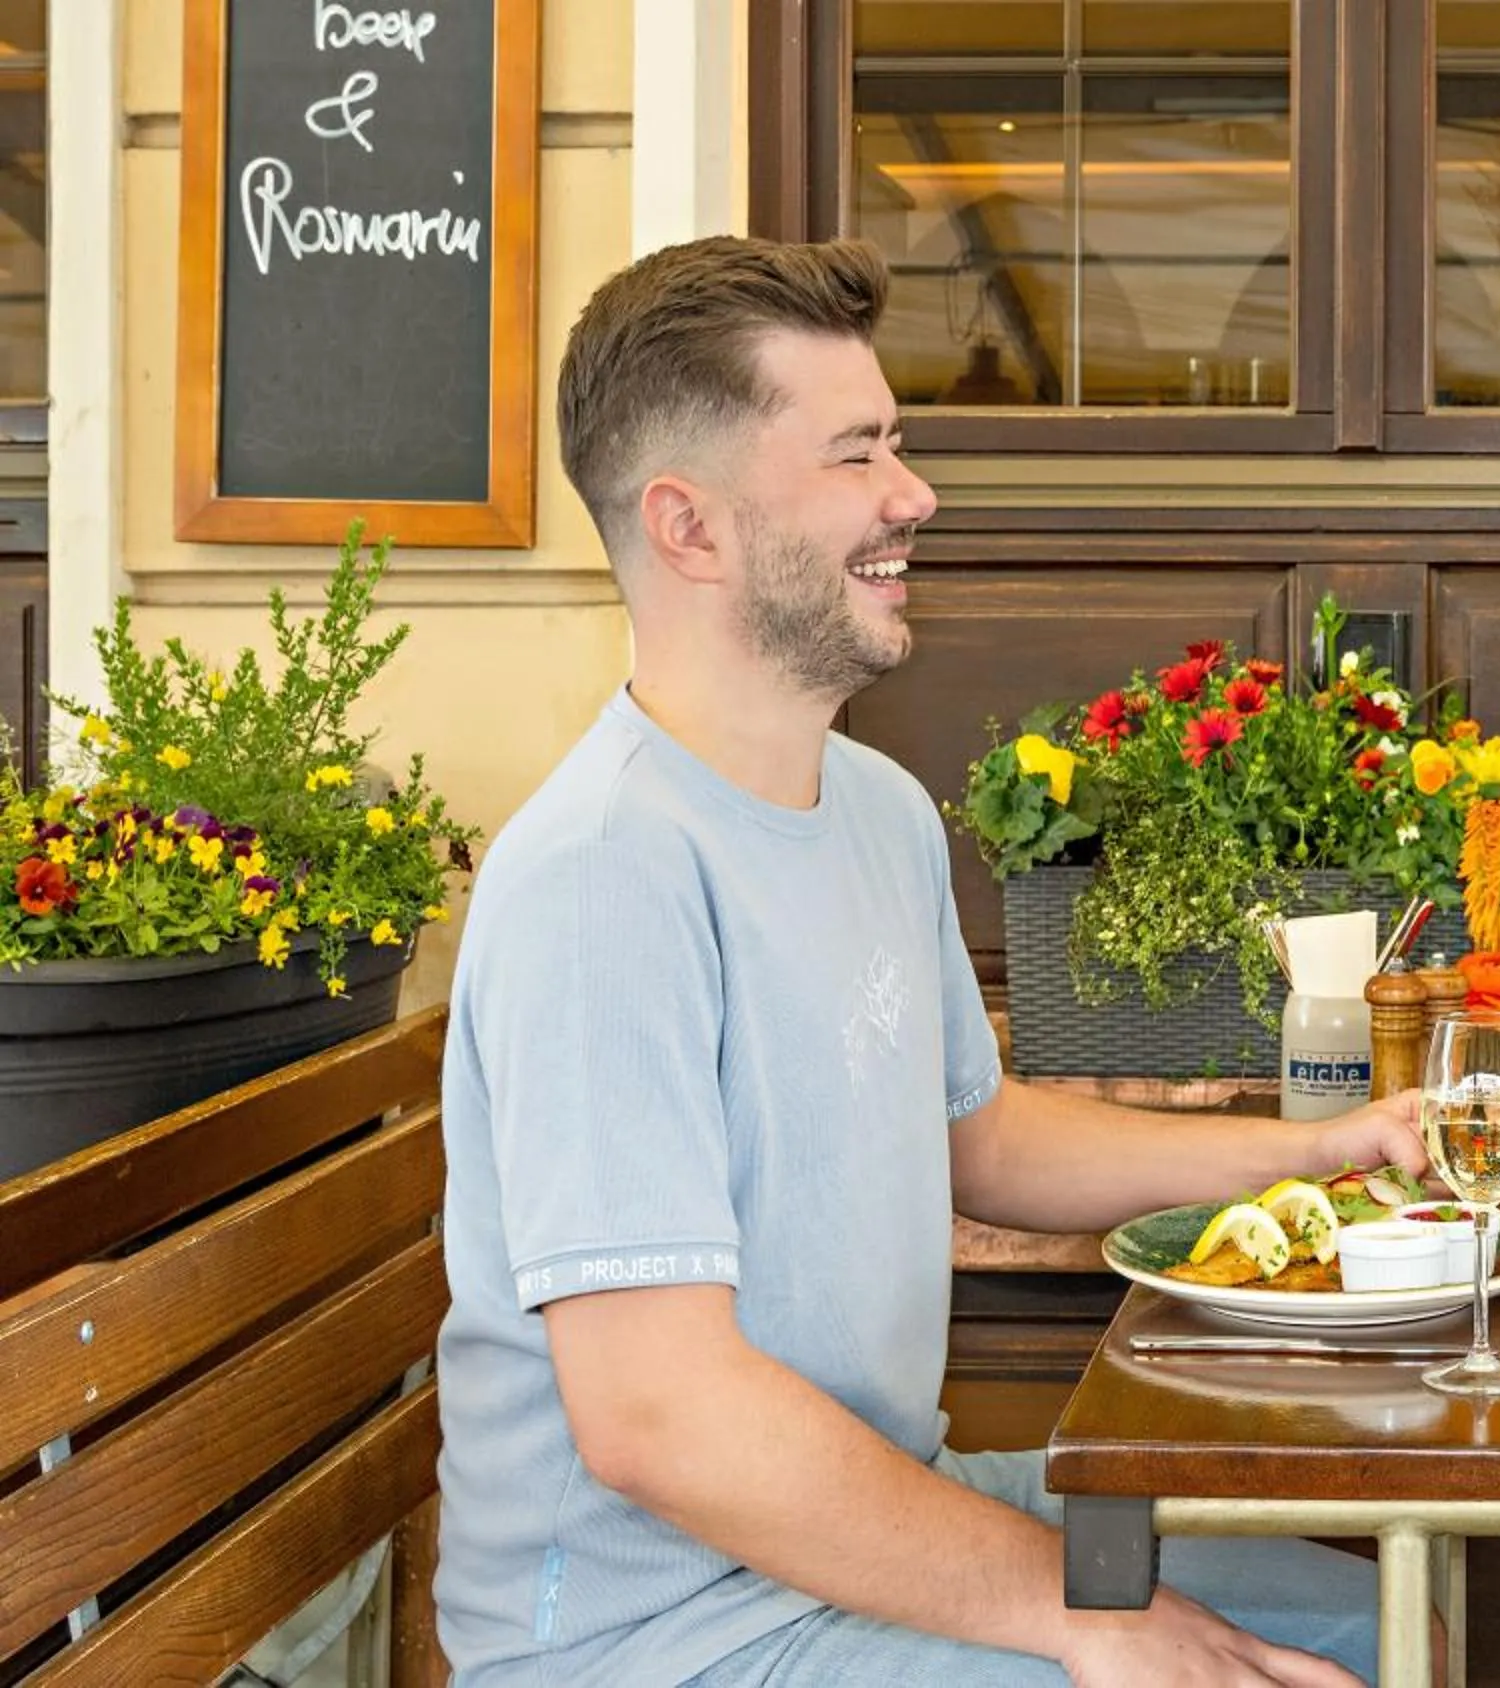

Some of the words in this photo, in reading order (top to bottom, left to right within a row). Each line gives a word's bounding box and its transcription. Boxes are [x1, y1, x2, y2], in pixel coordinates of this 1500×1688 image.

[304, 70, 379, 153] &
[240, 157, 479, 275] Rosmarin
[1297, 1061, 1360, 1084] eiche
[581, 1255, 677, 1283] PROJECT
[691, 1253, 705, 1276] X
